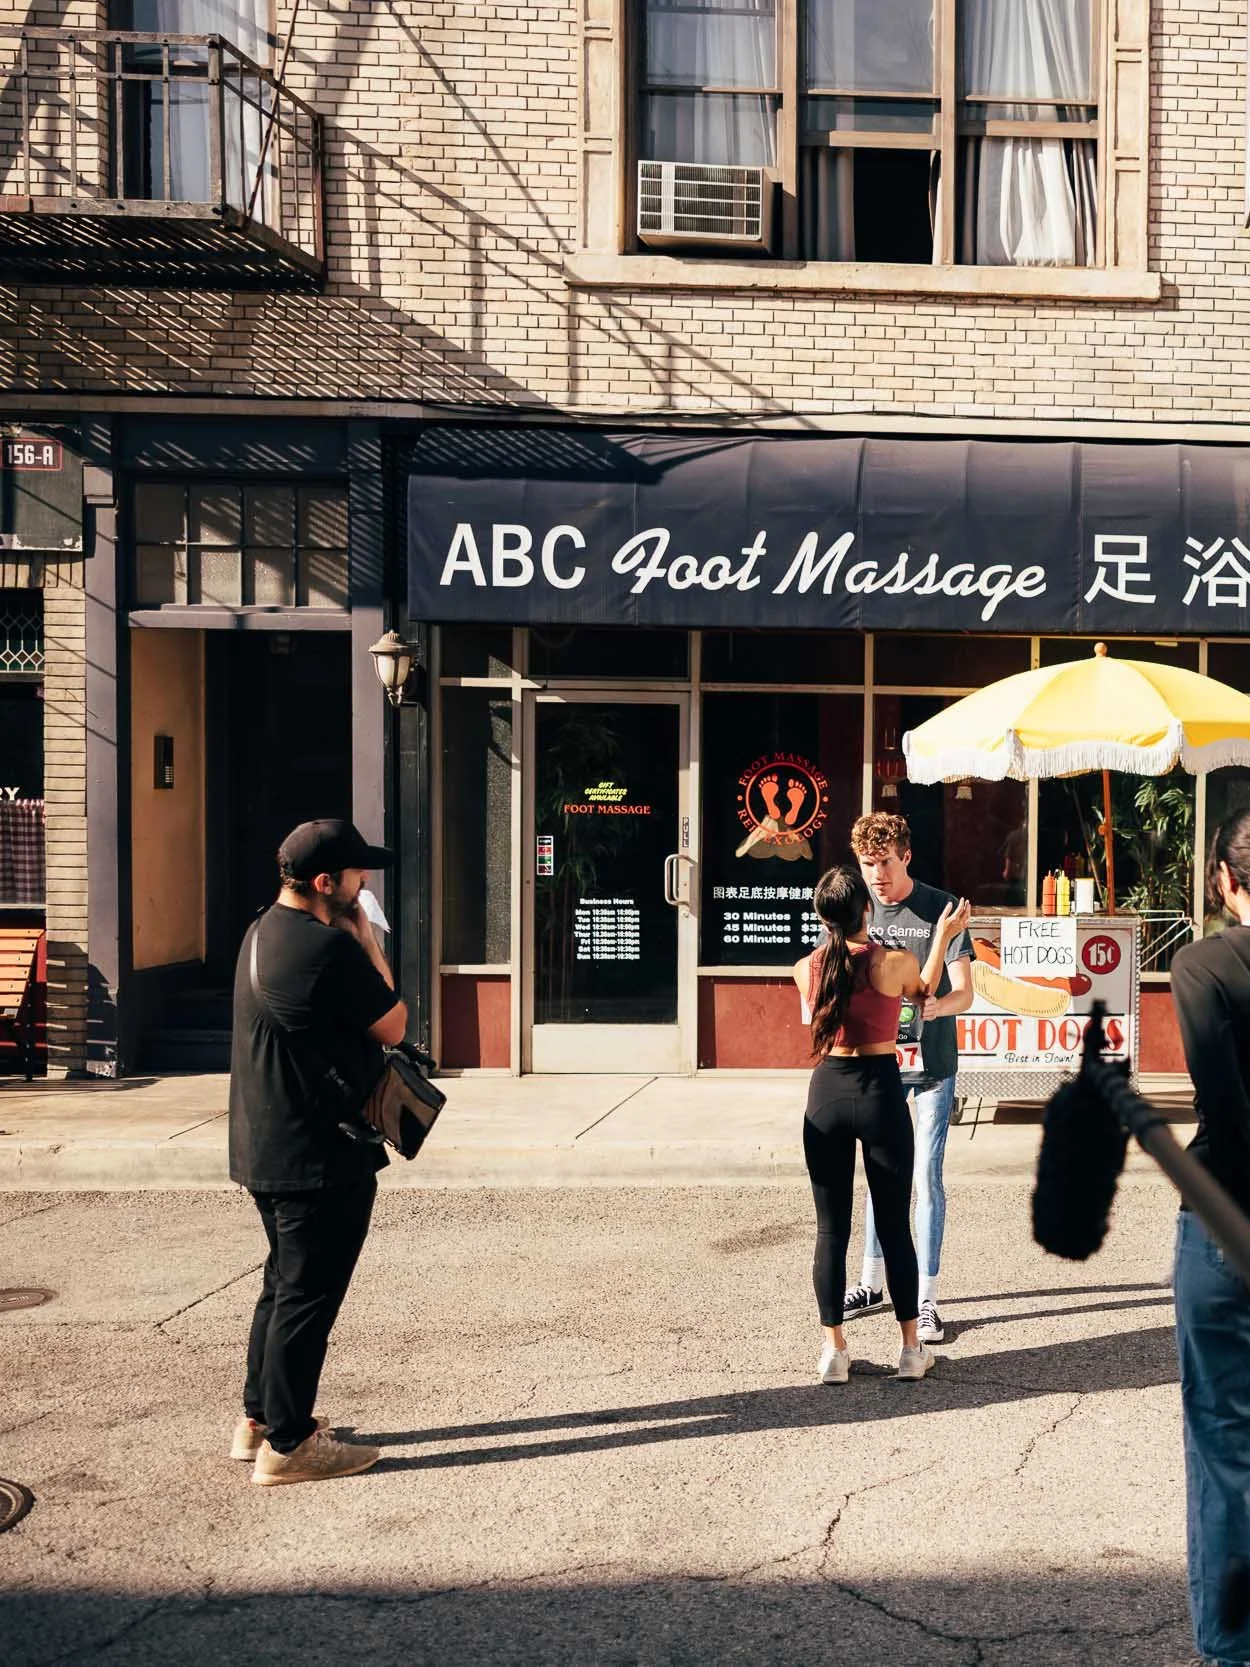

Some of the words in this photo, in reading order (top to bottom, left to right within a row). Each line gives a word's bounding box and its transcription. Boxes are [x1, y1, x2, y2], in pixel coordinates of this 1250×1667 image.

[8, 444, 54, 466] 156-A
[439, 522, 586, 590] ABC
[611, 527, 767, 594] Foot
[772, 531, 1047, 622] Massage
[563, 804, 594, 814] FOOT
[597, 805, 652, 815] MASSAGE
[723, 912, 740, 921] 30
[743, 912, 791, 921] Minutes
[723, 923, 740, 932] 45
[743, 923, 791, 932] Minutes
[887, 925, 931, 938] Games
[1018, 920, 1062, 939] FREE
[723, 935, 740, 944] 60
[743, 935, 791, 944] Minutes
[1003, 945, 1033, 965] HOT
[1037, 945, 1074, 965] DOGS
[1086, 943, 1115, 967] 15¢
[957, 1018, 1022, 1051] HOT
[1004, 1052, 1030, 1064] Best
[1031, 1053, 1041, 1063] in
